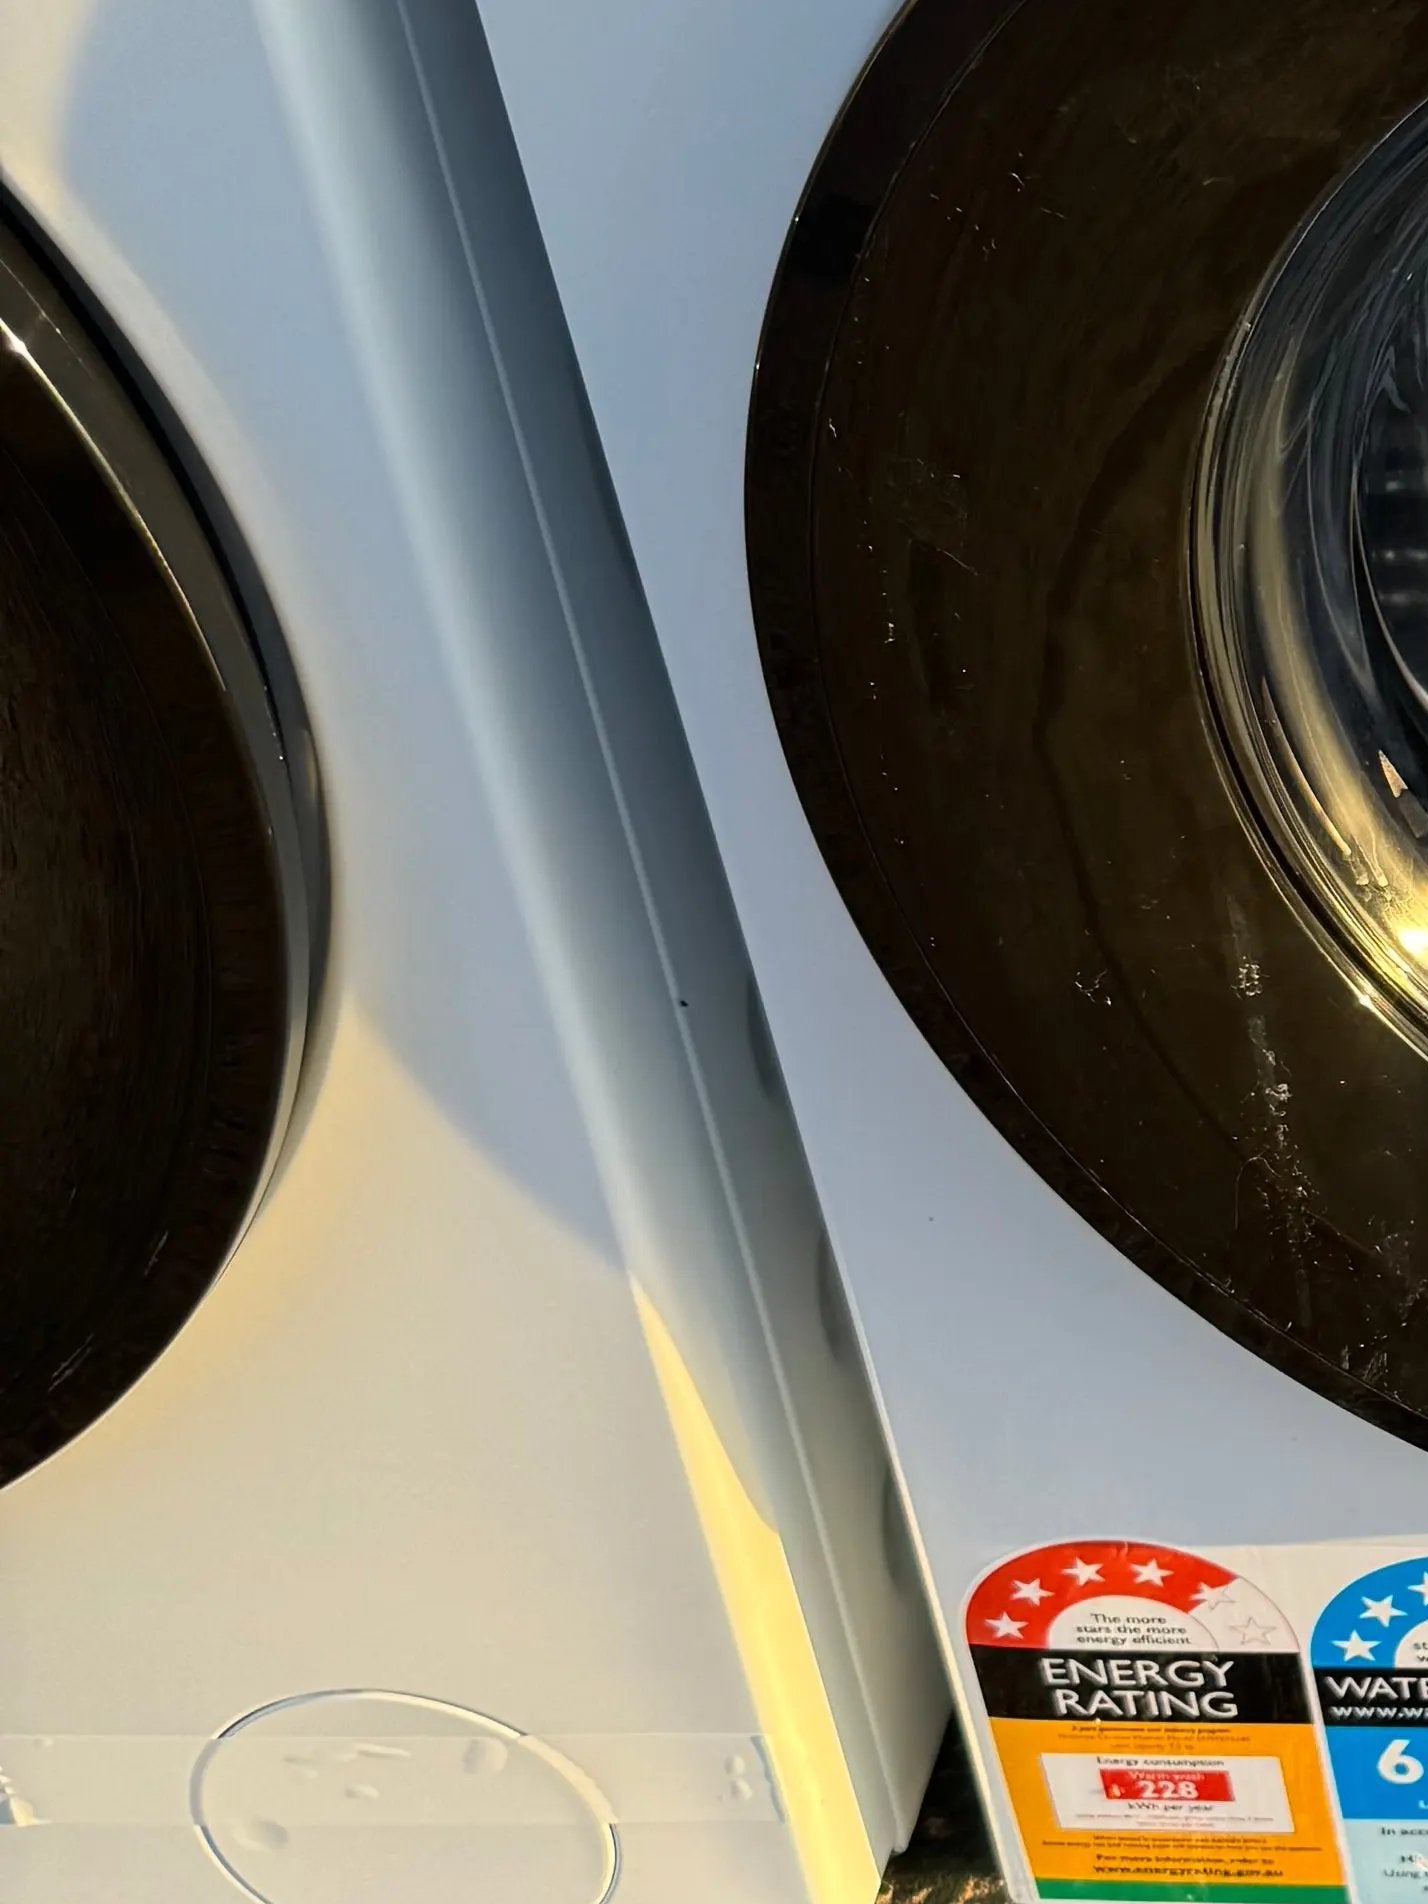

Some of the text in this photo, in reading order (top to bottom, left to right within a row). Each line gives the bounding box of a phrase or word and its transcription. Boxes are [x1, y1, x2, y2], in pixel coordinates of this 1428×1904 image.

[1091, 1613, 1167, 1624] The more
[1077, 1625, 1187, 1635] stars the more
[1077, 1635, 1192, 1646] energy efficient
[1039, 1657, 1235, 1688] ENERGY
[1052, 1689, 1238, 1719] RATING
[1137, 1781, 1199, 1799] 228
